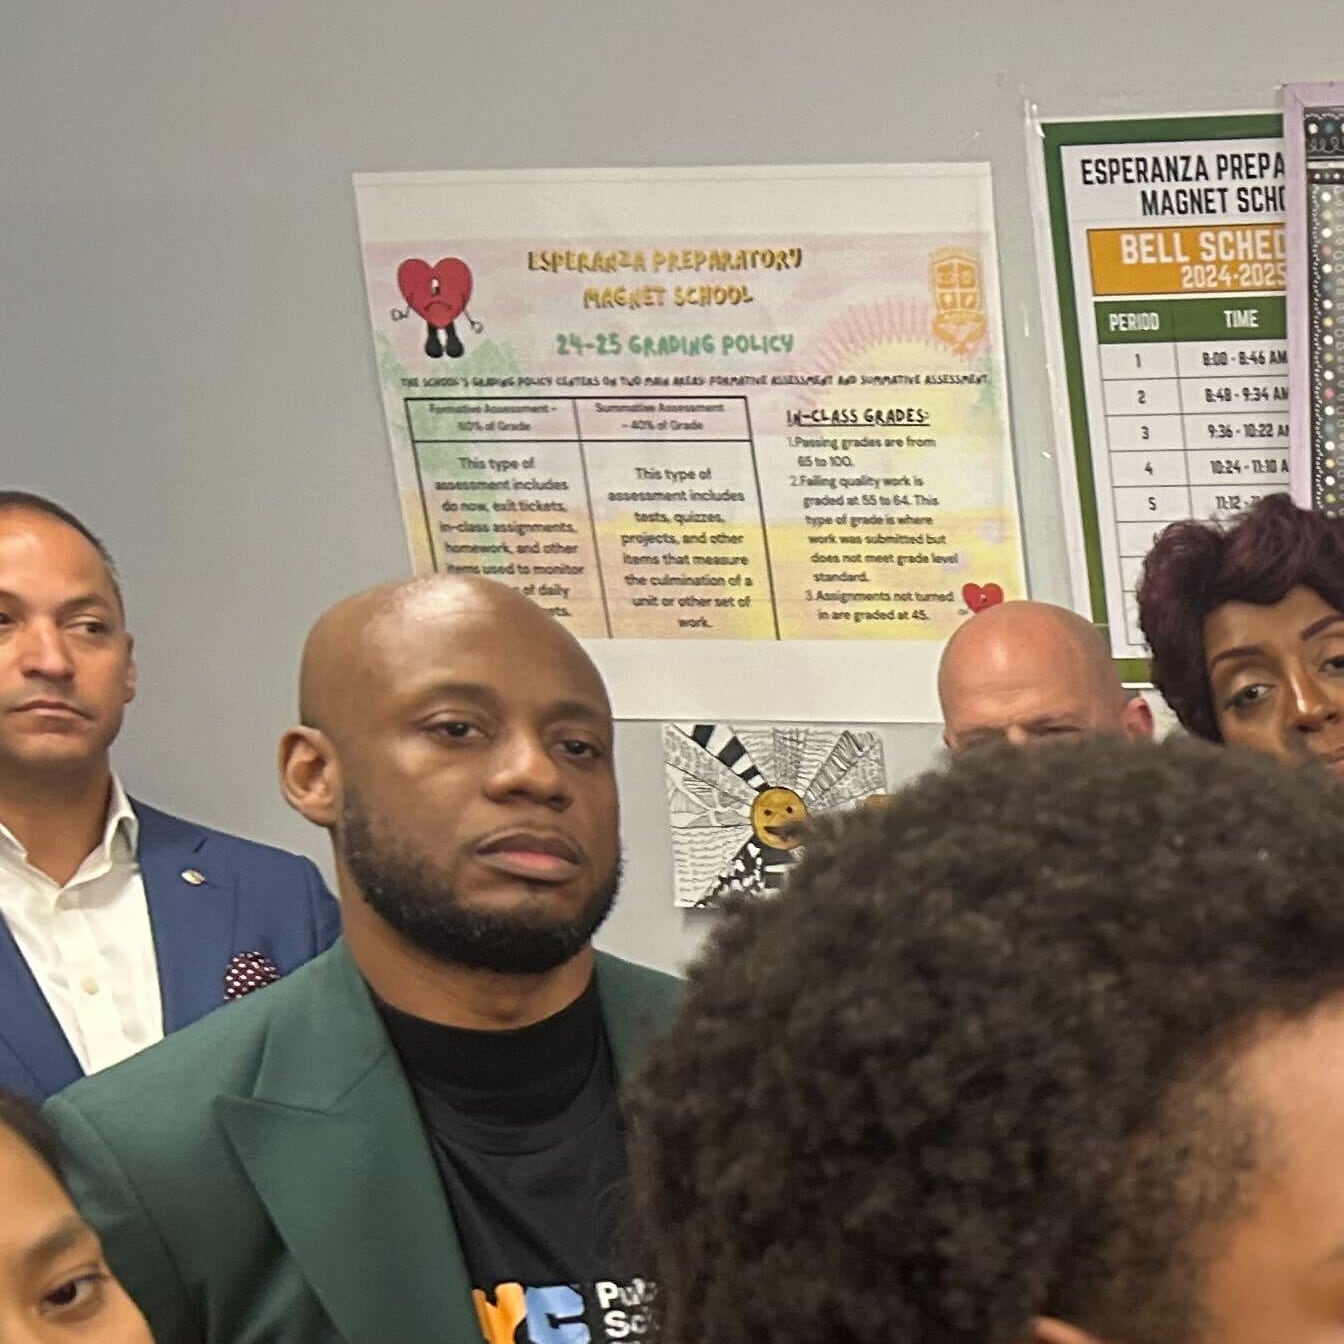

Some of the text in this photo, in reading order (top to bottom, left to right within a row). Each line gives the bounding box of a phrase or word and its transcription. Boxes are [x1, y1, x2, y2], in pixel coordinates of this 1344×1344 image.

[1081, 155, 1209, 186] ESPERANZA
[1140, 188, 1228, 216] MAGNET
[1120, 232, 1190, 265] BELL
[528, 248, 803, 273] ESPERANZA PREPARATORY
[1181, 263, 1287, 289] 2024-2025
[583, 284, 754, 309] MAGNET SCHOOL
[1109, 309, 1259, 332] PERIOD TIME
[556, 333, 794, 357] 24-25 GRADING POLICY
[1202, 350, 1288, 366] 8:00 8:46 AM
[1137, 389, 1147, 405] 2
[1242, 386, 1269, 401] 9:34
[1141, 423, 1274, 440] 3 9:36 10:22
[635, 467, 696, 482] This type
[1144, 462, 1154, 476] 4
[1149, 496, 1157, 511] 5
[683, 534, 707, 545] and
[710, 534, 744, 545] other
[843, 553, 861, 564] not
